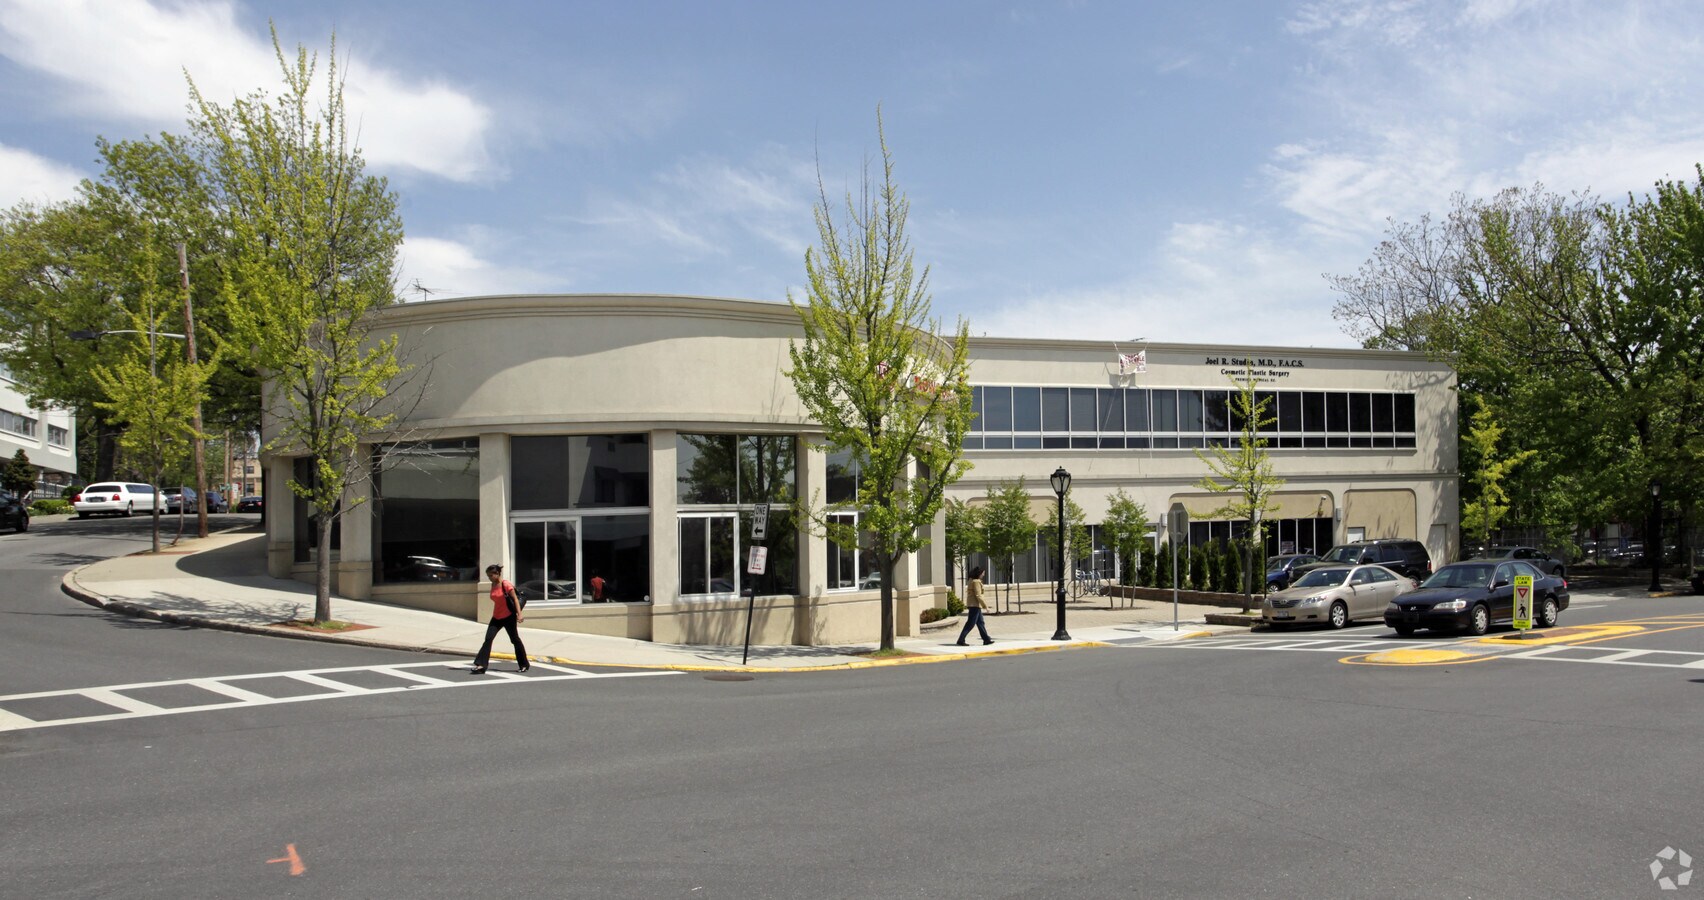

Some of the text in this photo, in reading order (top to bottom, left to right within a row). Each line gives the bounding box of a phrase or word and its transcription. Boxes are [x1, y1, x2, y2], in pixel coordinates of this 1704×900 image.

[1205, 357, 1219, 365] Joel
[1220, 368, 1246, 376] Cosmetic
[756, 506, 766, 515] ONE
[754, 516, 766, 524] WAY
